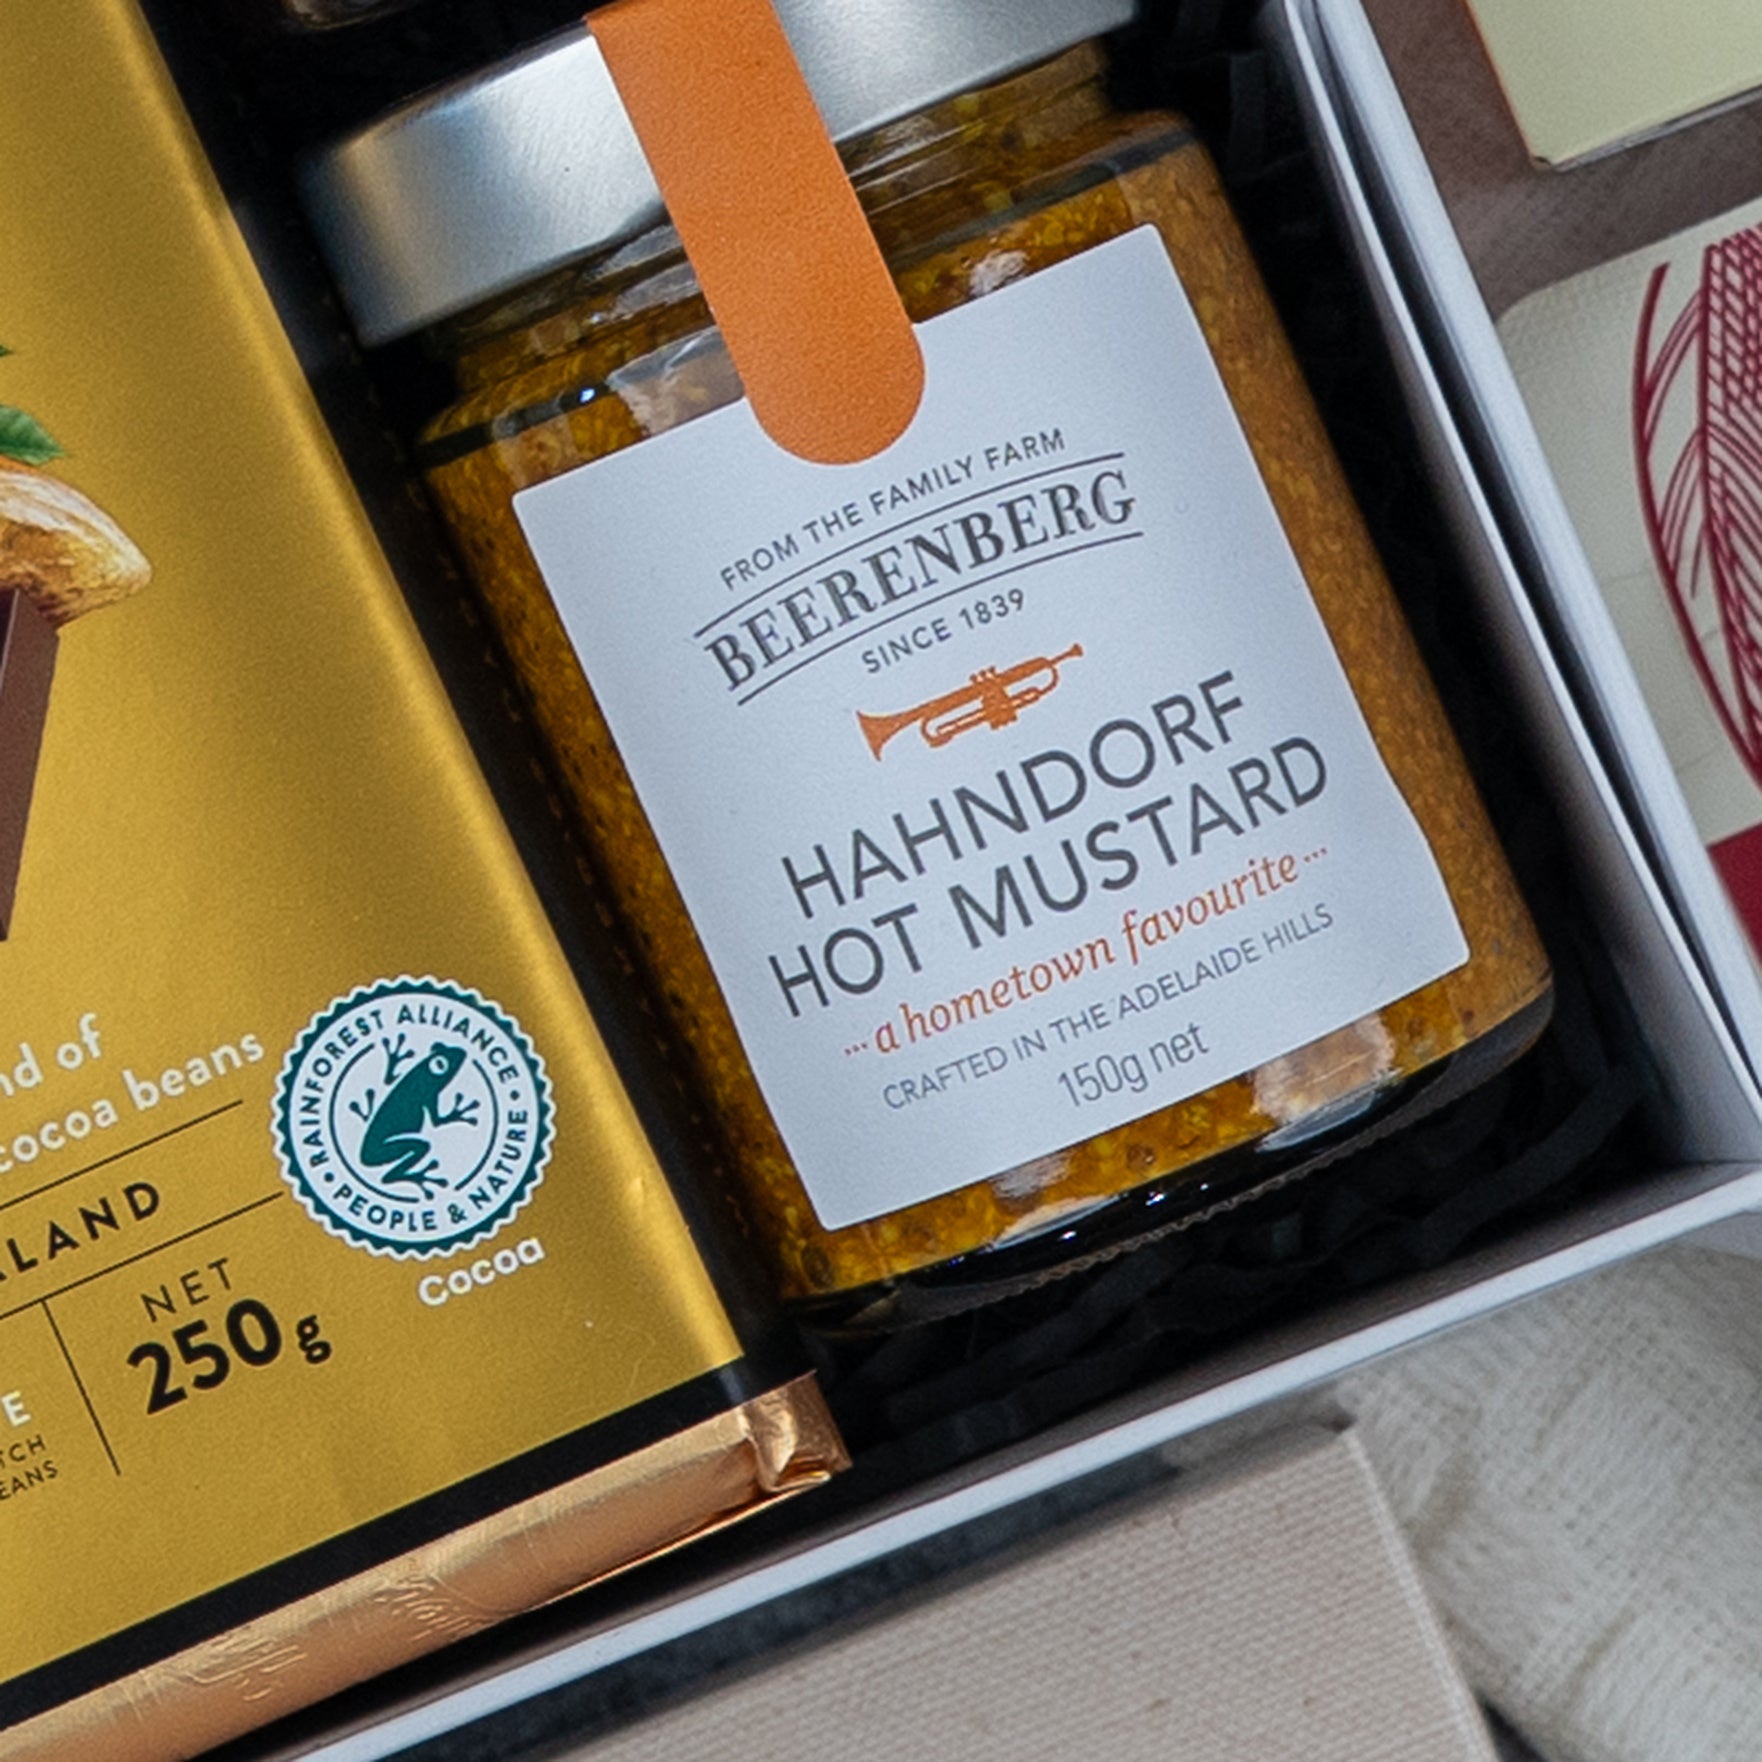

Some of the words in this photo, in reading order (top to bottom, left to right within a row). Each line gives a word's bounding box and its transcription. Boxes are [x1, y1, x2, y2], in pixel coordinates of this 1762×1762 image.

[720, 533, 799, 591] FROM
[803, 502, 863, 544] THE
[869, 455, 972, 516] FAMILY
[984, 427, 1065, 471] FARM
[703, 470, 1136, 692] BEERENBERG
[861, 617, 952, 674] SINCE
[958, 588, 1024, 630] 1839
[781, 669, 1243, 920] HAHNDORF
[768, 902, 922, 1018] HOT
[947, 736, 1327, 950] MUSTARD
[56, 1012, 101, 1070] of
[883, 1046, 1008, 1109] CRAFTED
[1012, 1029, 1047, 1061] IN
[1049, 1002, 1111, 1043] THE
[1119, 938, 1261, 1019] ADELAIDE
[1262, 903, 1333, 953] HILLS
[899, 937, 1116, 1044] hometown
[121, 1033, 265, 1111] beans
[299, 1009, 384, 1169] RAINFOREST
[396, 1003, 520, 1085] ALLIANCE
[1057, 1053, 1149, 1107] 150g
[1148, 1022, 1209, 1073] net
[332, 1183, 438, 1233] PEOPLE
[446, 1202, 468, 1225] &
[468, 1109, 528, 1211] NATURE
[0, 1181, 160, 1283] LAND
[417, 1237, 546, 1306] Cocoa
[140, 1257, 231, 1323] NET
